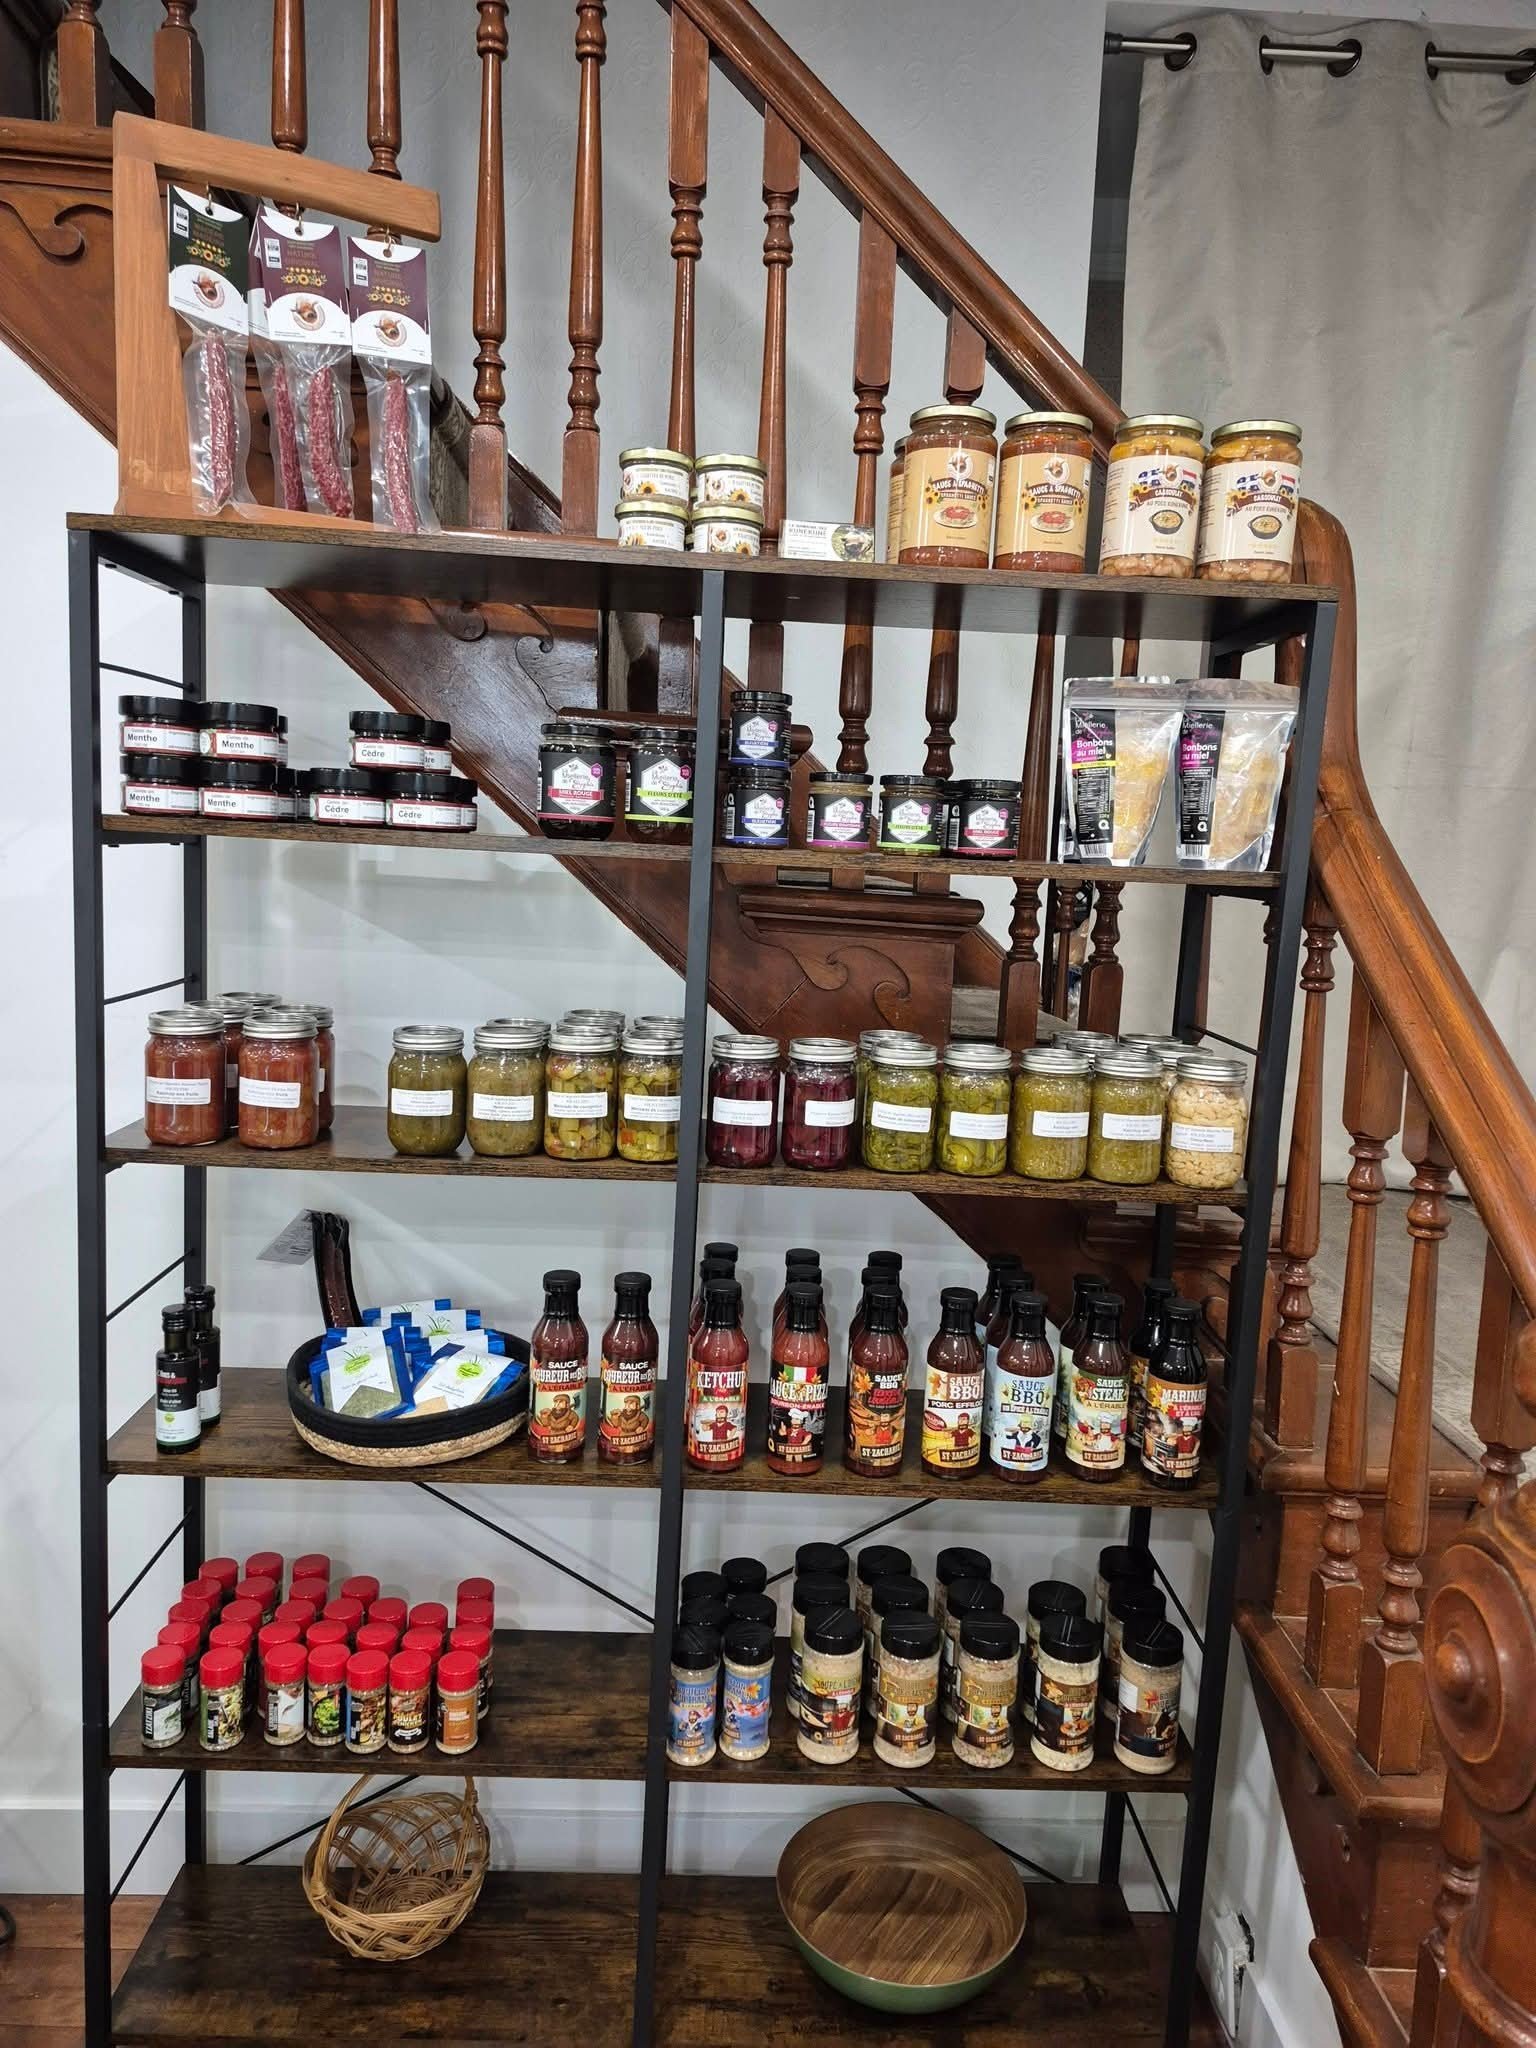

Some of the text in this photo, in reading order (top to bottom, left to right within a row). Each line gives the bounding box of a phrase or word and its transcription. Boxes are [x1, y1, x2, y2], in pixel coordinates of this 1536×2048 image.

[127, 733, 158, 743] Menthe
[222, 739, 255, 750] Menthe
[1076, 738, 1113, 749] Bonbons
[1182, 742, 1218, 752] Bonbons
[361, 748, 385, 758] Cèdre
[1088, 746, 1106, 756] miel
[1191, 751, 1210, 760] miel
[129, 793, 160, 803] Menthe
[207, 798, 237, 808] Menthe
[325, 804, 350, 814] Cèdre
[398, 810, 422, 819] Cèdre
[548, 1360, 578, 1369] SAUCE
[619, 1361, 648, 1370] SAUCE
[534, 1369, 569, 1383] COUREUR
[604, 1369, 640, 1384] COUREUR
[874, 1373, 903, 1382] SAUCE
[949, 1375, 980, 1386] SAUCE
[1011, 1380, 1046, 1391] SAUCE
[1096, 1378, 1124, 1388] SAUCE
[949, 1385, 979, 1400] BBQ
[1010, 1388, 1045, 1406] BBQ
[1091, 1388, 1125, 1401] STEAK
[931, 1400, 954, 1409] PORC
[393, 1712, 422, 1722] POULET
